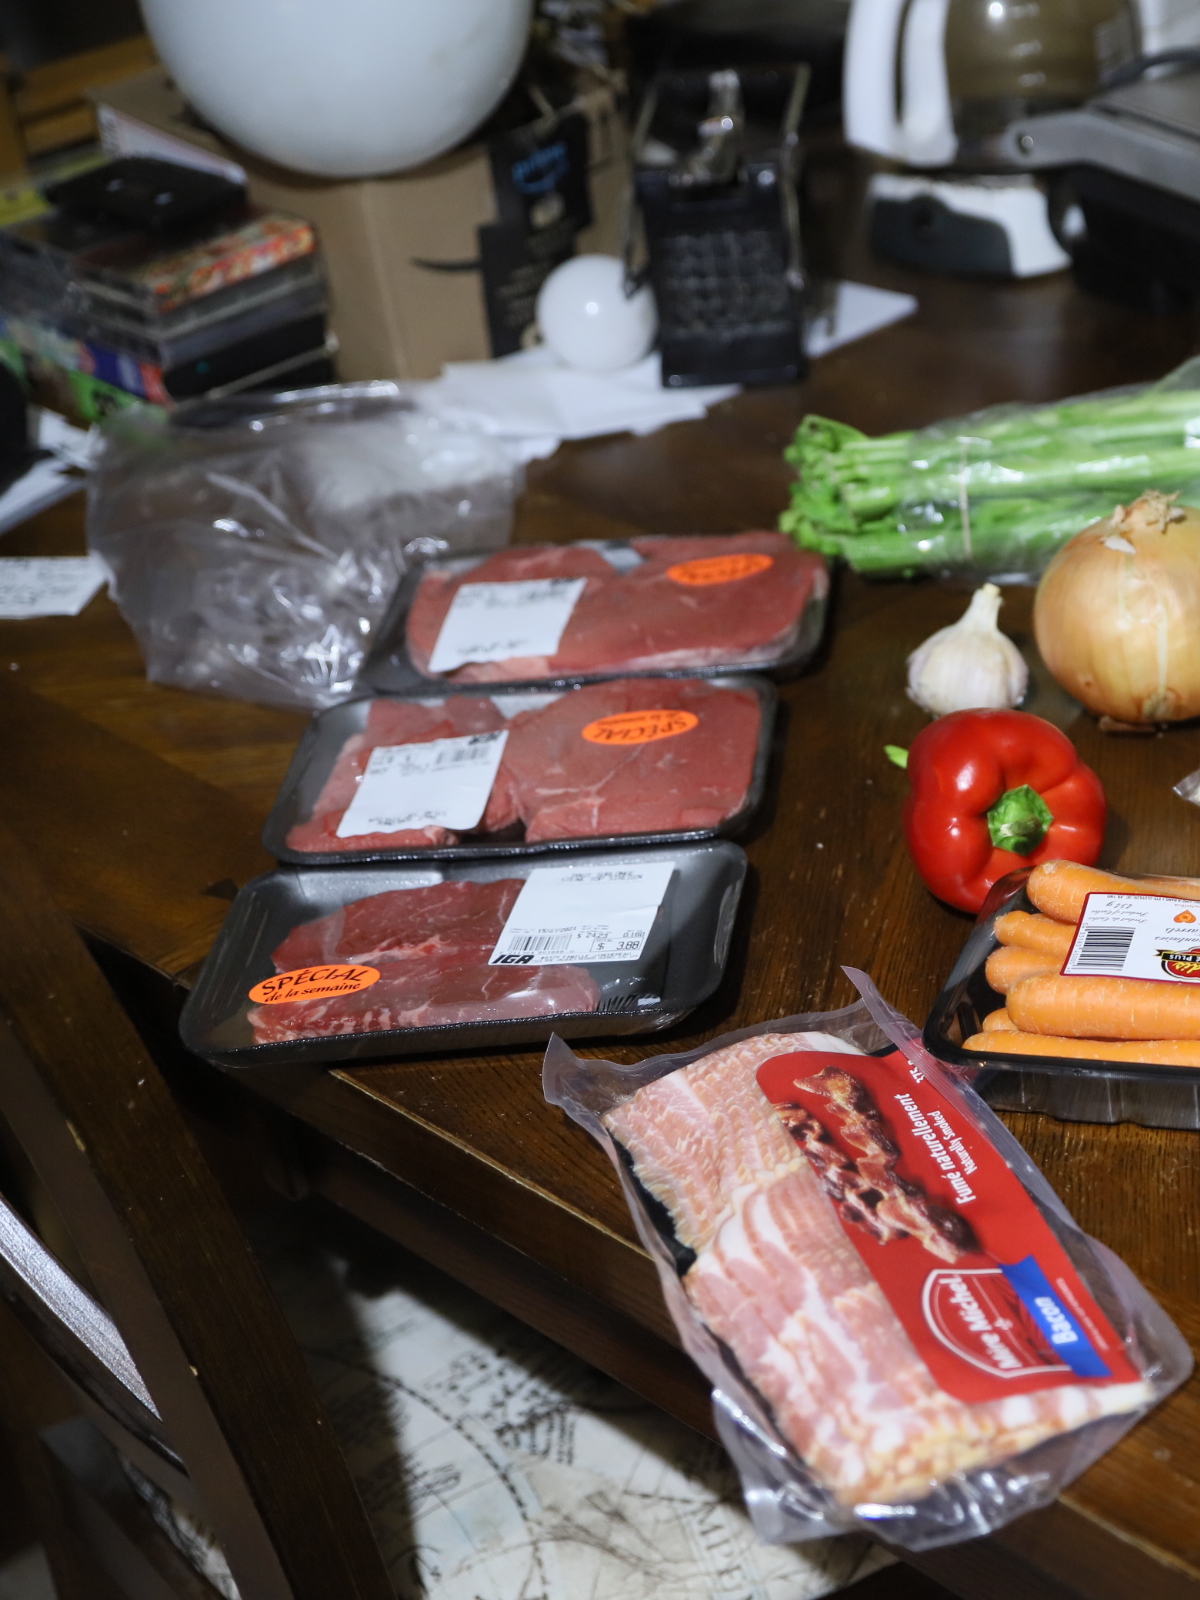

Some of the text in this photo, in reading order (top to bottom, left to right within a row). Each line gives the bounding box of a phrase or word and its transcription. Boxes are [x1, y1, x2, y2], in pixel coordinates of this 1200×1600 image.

[597, 940, 640, 951] $ 3.88
[492, 954, 535, 964] IGA
[1169, 954, 1194, 962] PLUS
[261, 968, 369, 996] SPÉCIAL
[264, 982, 361, 1003] de la semaine
[908, 1068, 926, 1085] 375
[894, 1092, 977, 1205] Fumé naturellement
[927, 1110, 978, 1175] Naturally Smoked
[938, 1275, 1022, 1371] Mère Michel
[1034, 1297, 1079, 1345] Bacon
